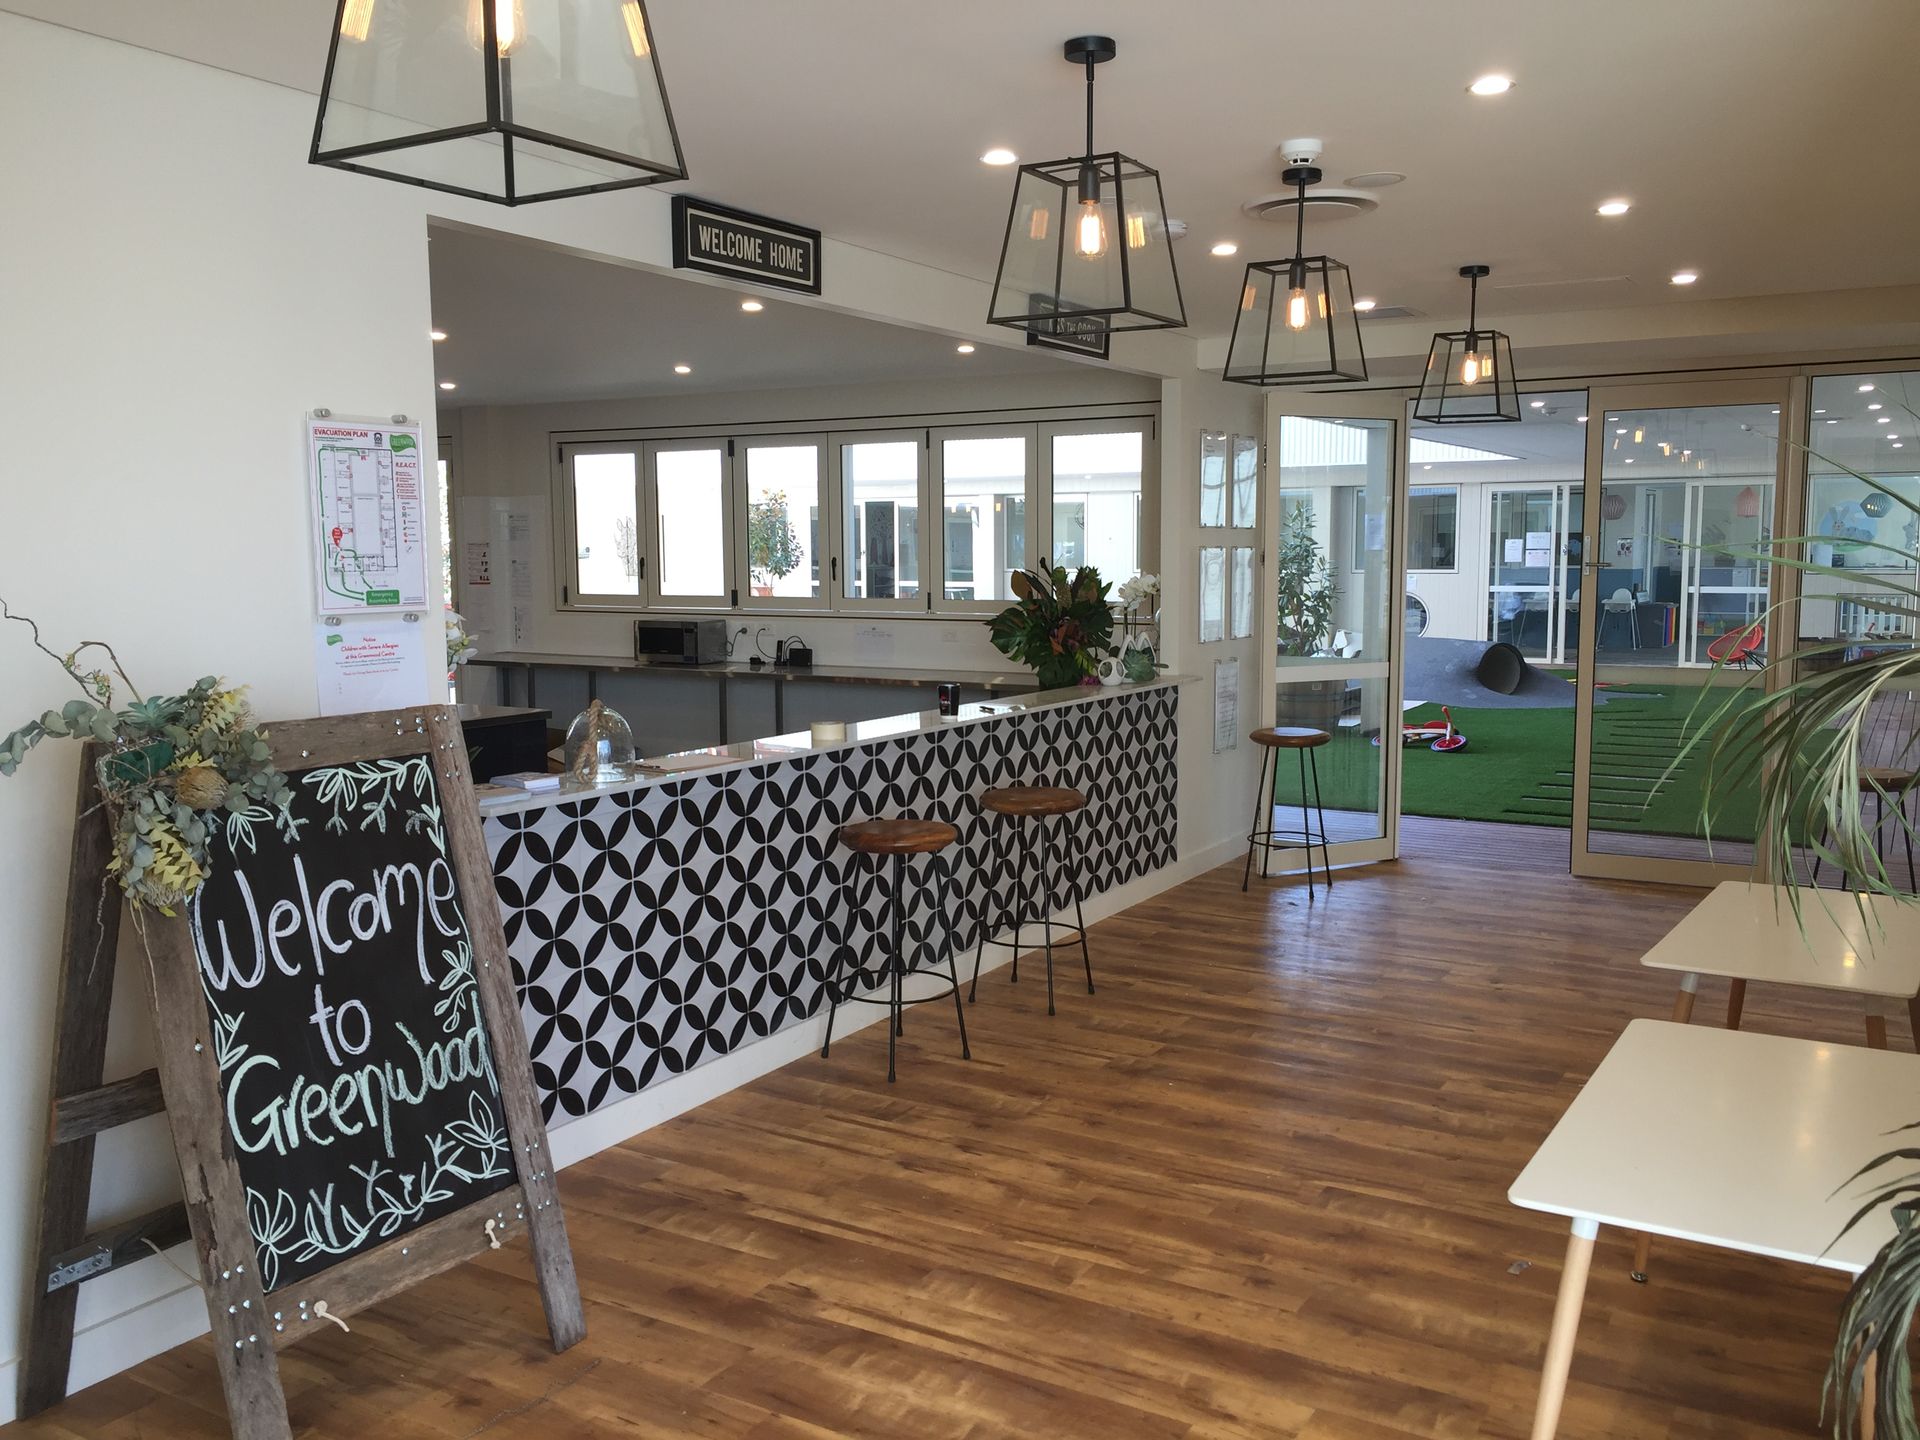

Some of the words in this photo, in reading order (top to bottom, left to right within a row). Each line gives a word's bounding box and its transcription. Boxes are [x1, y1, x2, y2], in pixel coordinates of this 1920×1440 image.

[699, 224, 762, 263] WELCOME
[770, 242, 803, 272] HOME
[314, 429, 352, 437] EVACUATION
[196, 853, 462, 992] Welcome
[307, 983, 371, 1067] to
[226, 990, 499, 1158] Greenwood
